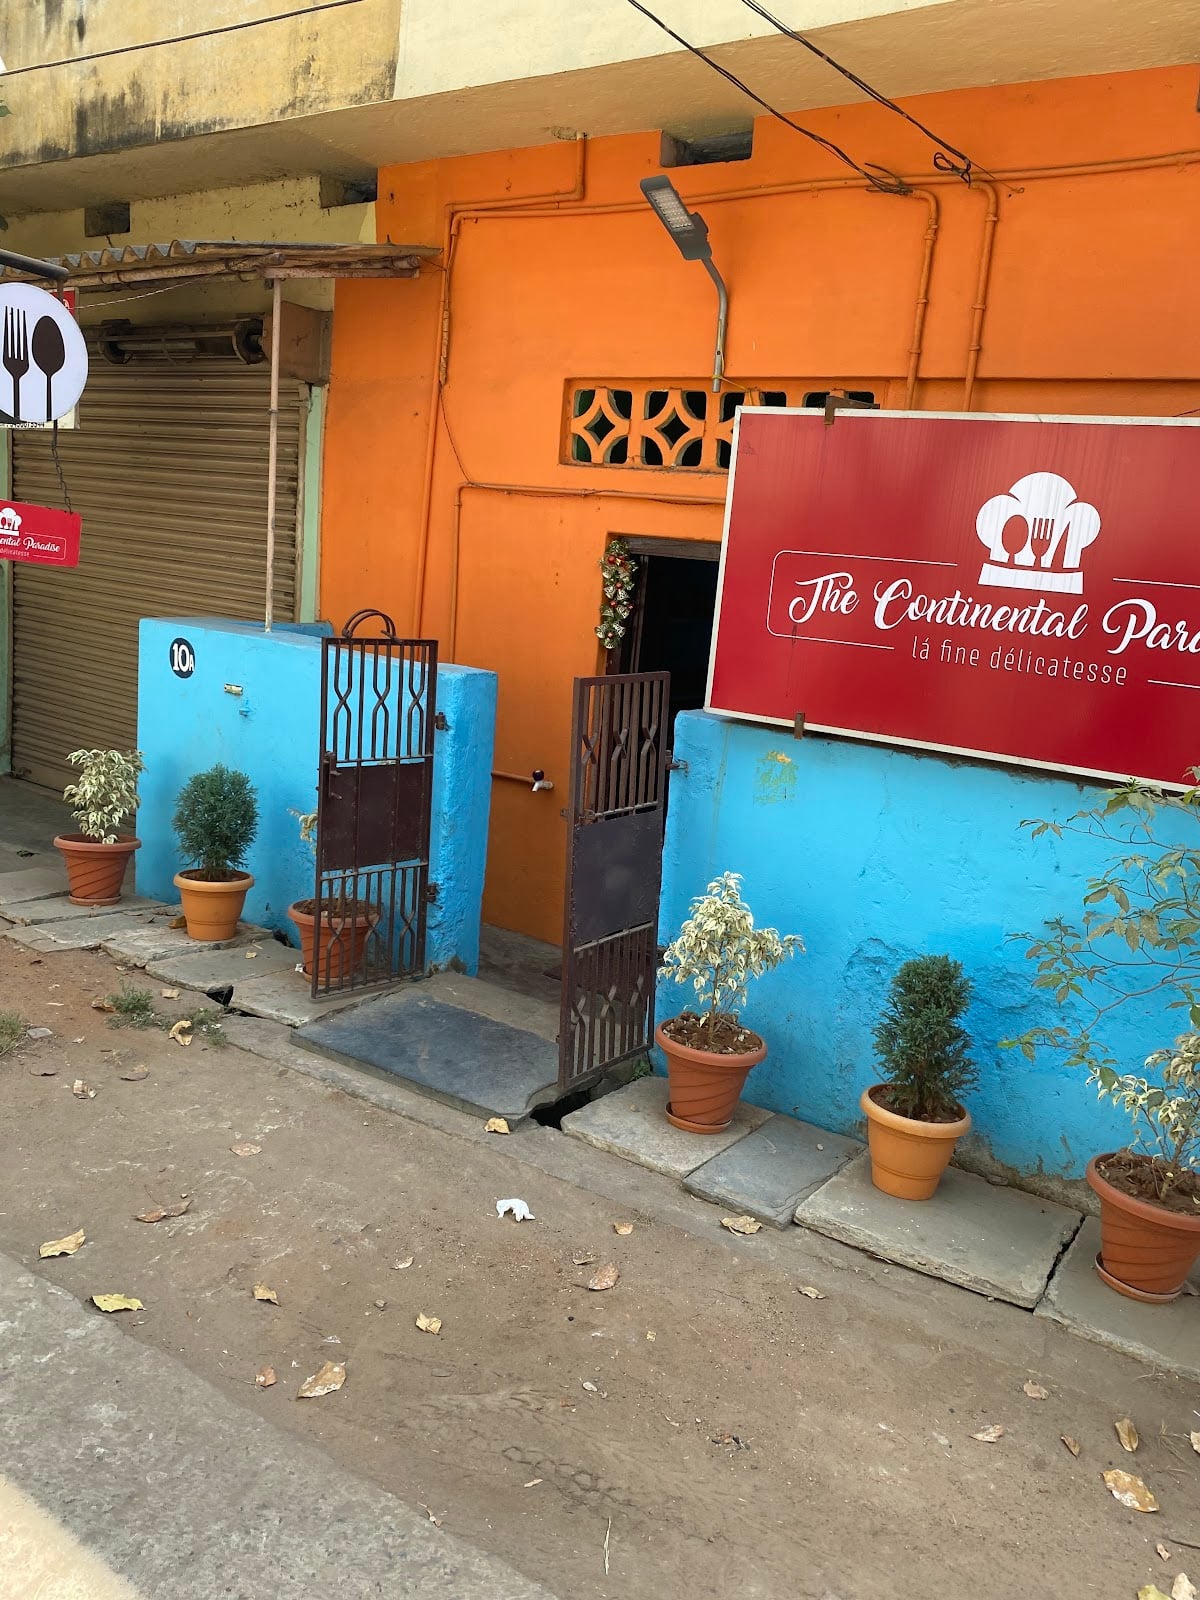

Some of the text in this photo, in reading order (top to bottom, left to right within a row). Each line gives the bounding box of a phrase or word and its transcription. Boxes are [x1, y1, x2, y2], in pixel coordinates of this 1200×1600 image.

[23, 537, 60, 552] Paradise
[788, 572, 860, 623] The
[873, 578, 1088, 640] Continental
[172, 643, 195, 672] 10A
[912, 635, 1127, 686] lá fine délicatesse
